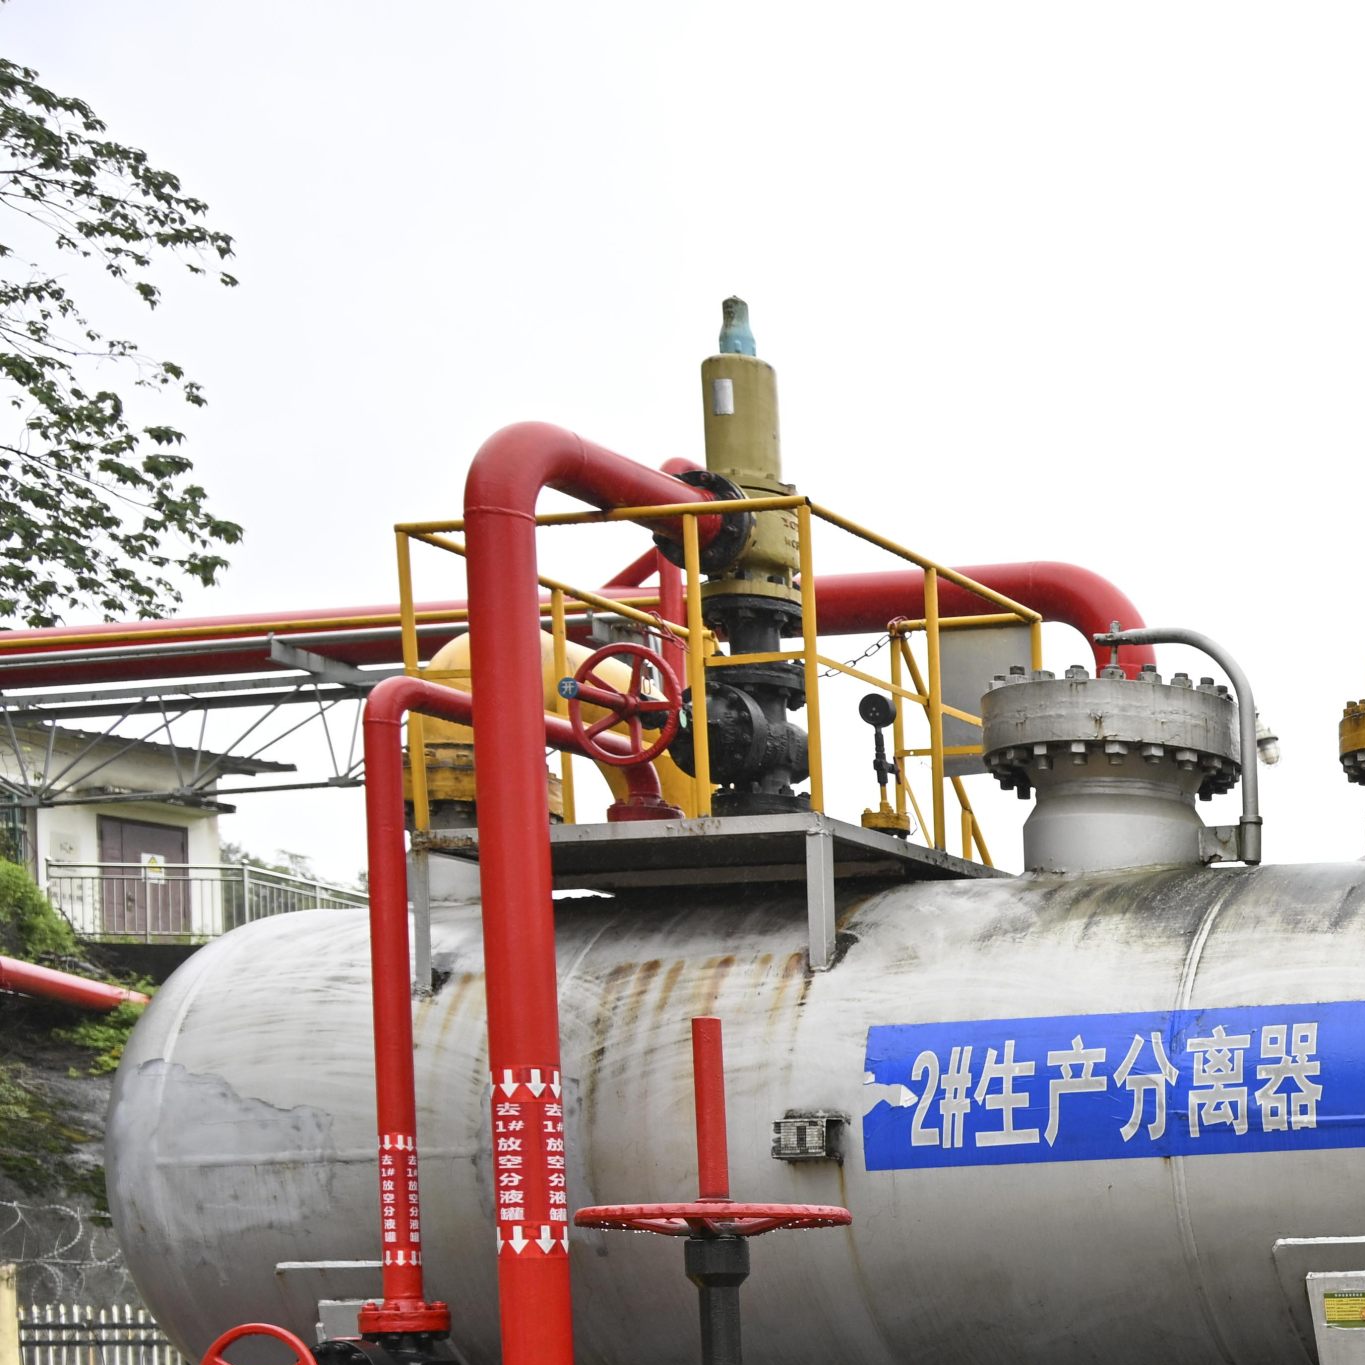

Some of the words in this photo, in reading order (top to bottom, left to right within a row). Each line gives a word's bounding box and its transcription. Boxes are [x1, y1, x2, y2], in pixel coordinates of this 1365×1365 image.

[911, 1022, 1323, 1149] 2#生产分离器
[496, 1102, 525, 1221] 去1#放空分液罐
